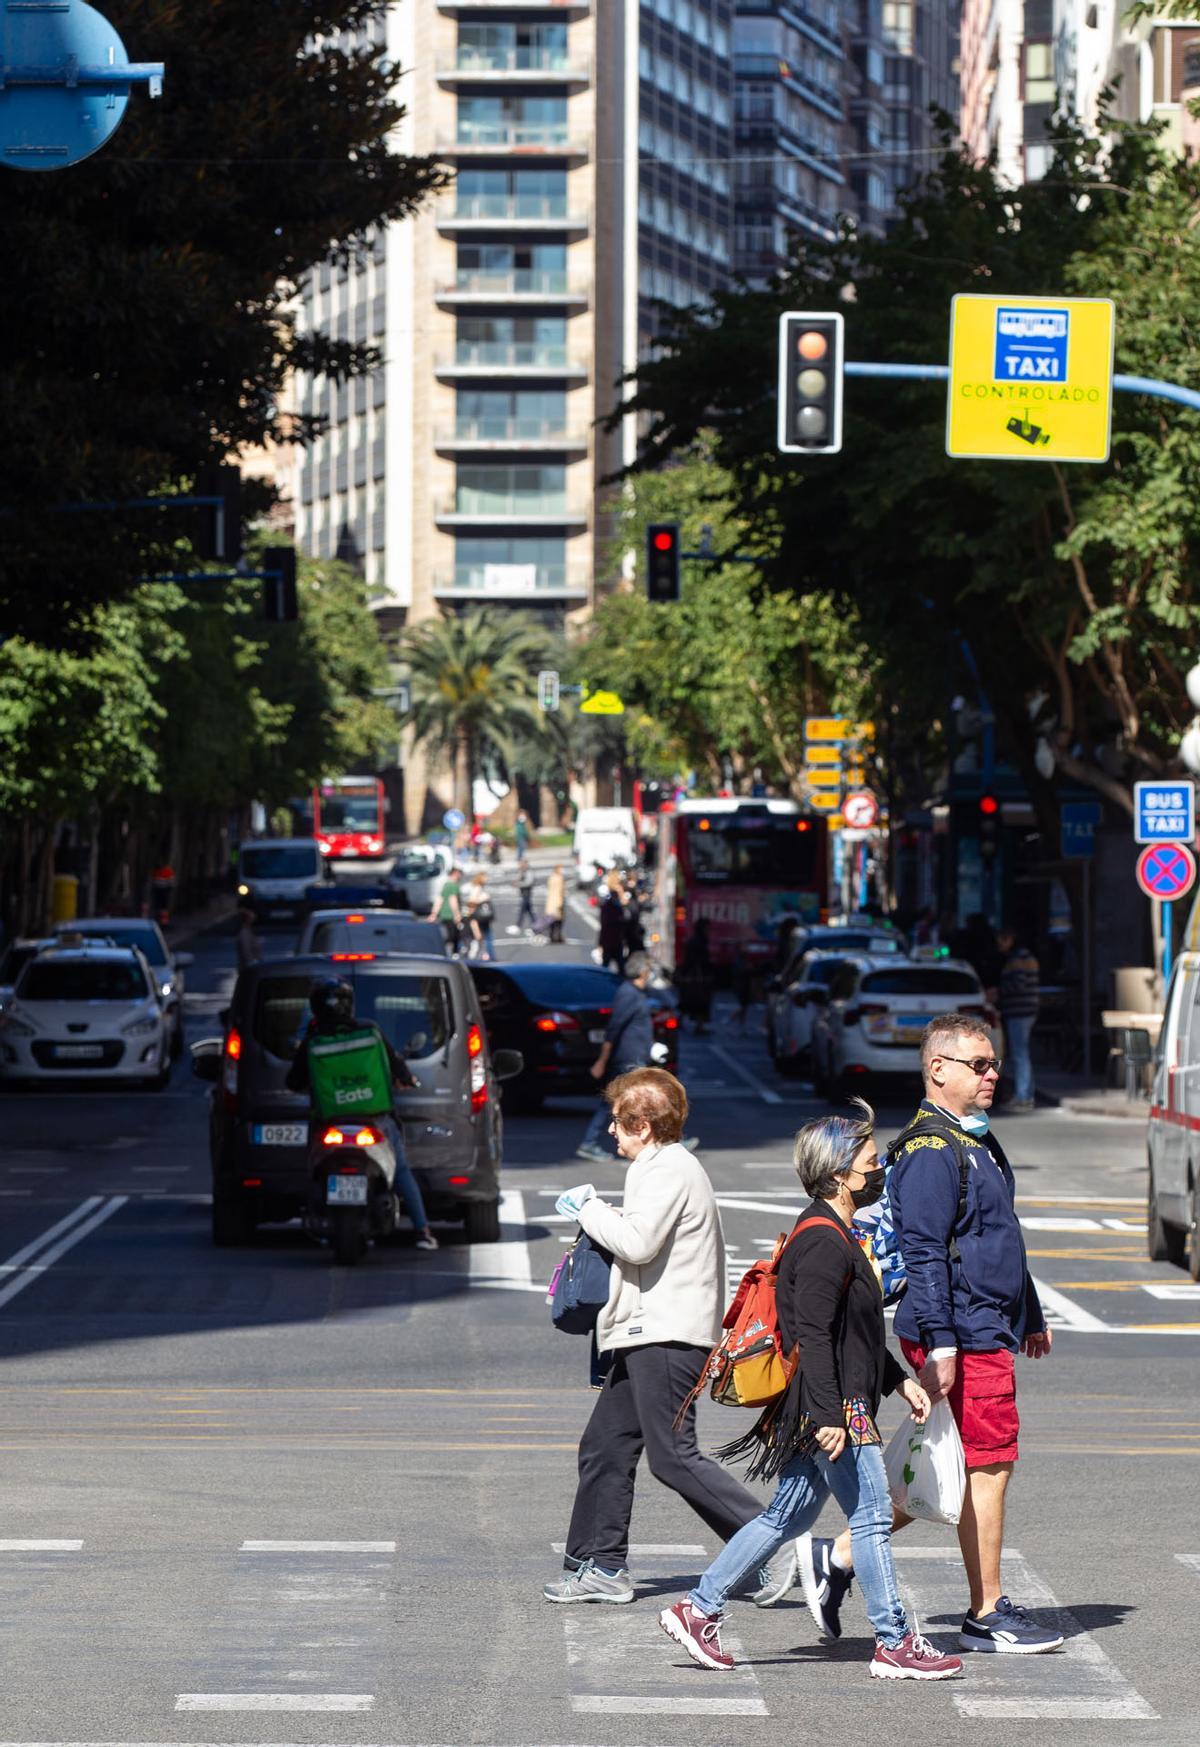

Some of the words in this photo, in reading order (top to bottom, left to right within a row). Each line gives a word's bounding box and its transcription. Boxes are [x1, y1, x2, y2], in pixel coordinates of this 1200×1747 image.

[1004, 356, 1059, 378] TAXI
[961, 384, 1100, 402] CONTROLADO
[1145, 792, 1183, 809] BUS
[1145, 816, 1185, 833] TAXI
[335, 1087, 374, 1105] Eats
[265, 1127, 303, 1142] 0922
